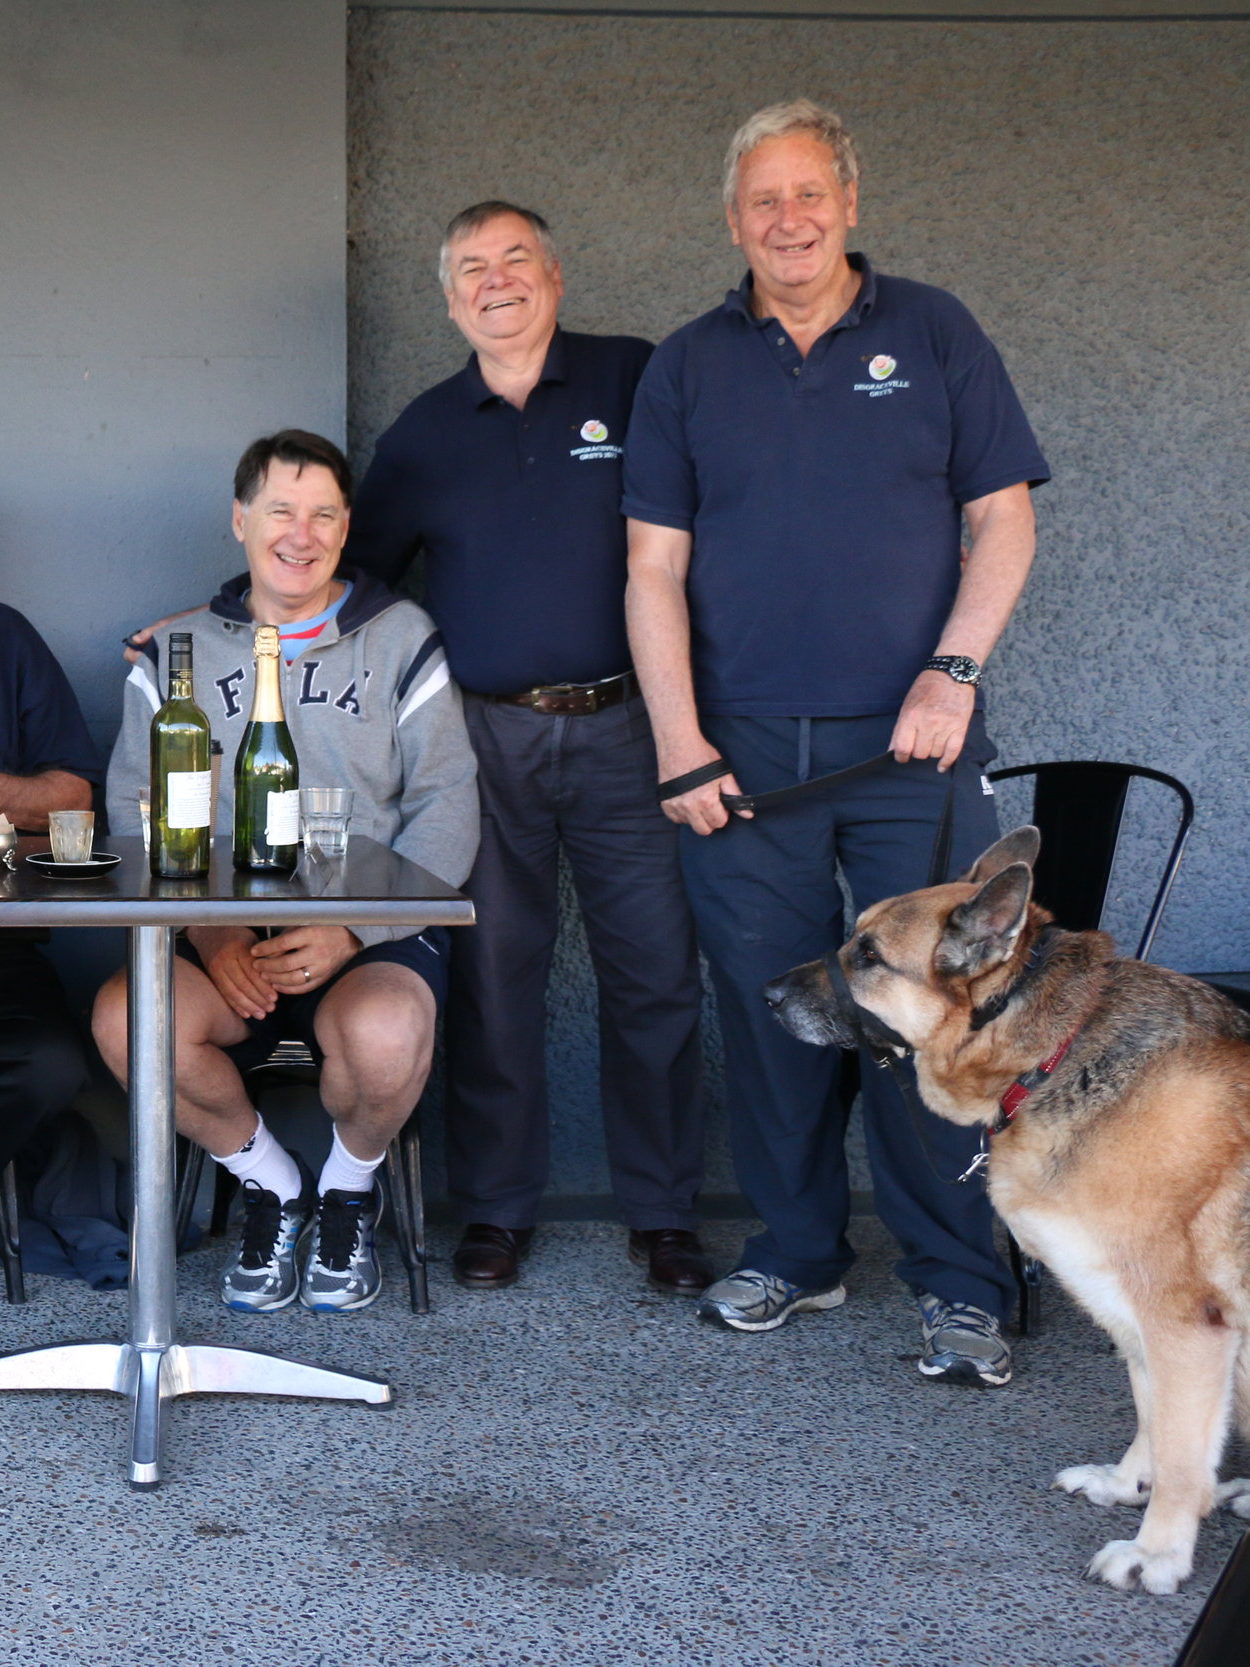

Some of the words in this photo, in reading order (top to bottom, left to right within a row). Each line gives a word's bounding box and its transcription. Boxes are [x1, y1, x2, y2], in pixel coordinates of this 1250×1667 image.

[853, 379, 909, 391] DISGRACEVILLE
[869, 388, 892, 398] GREYS
[214, 660, 373, 721] FLA
